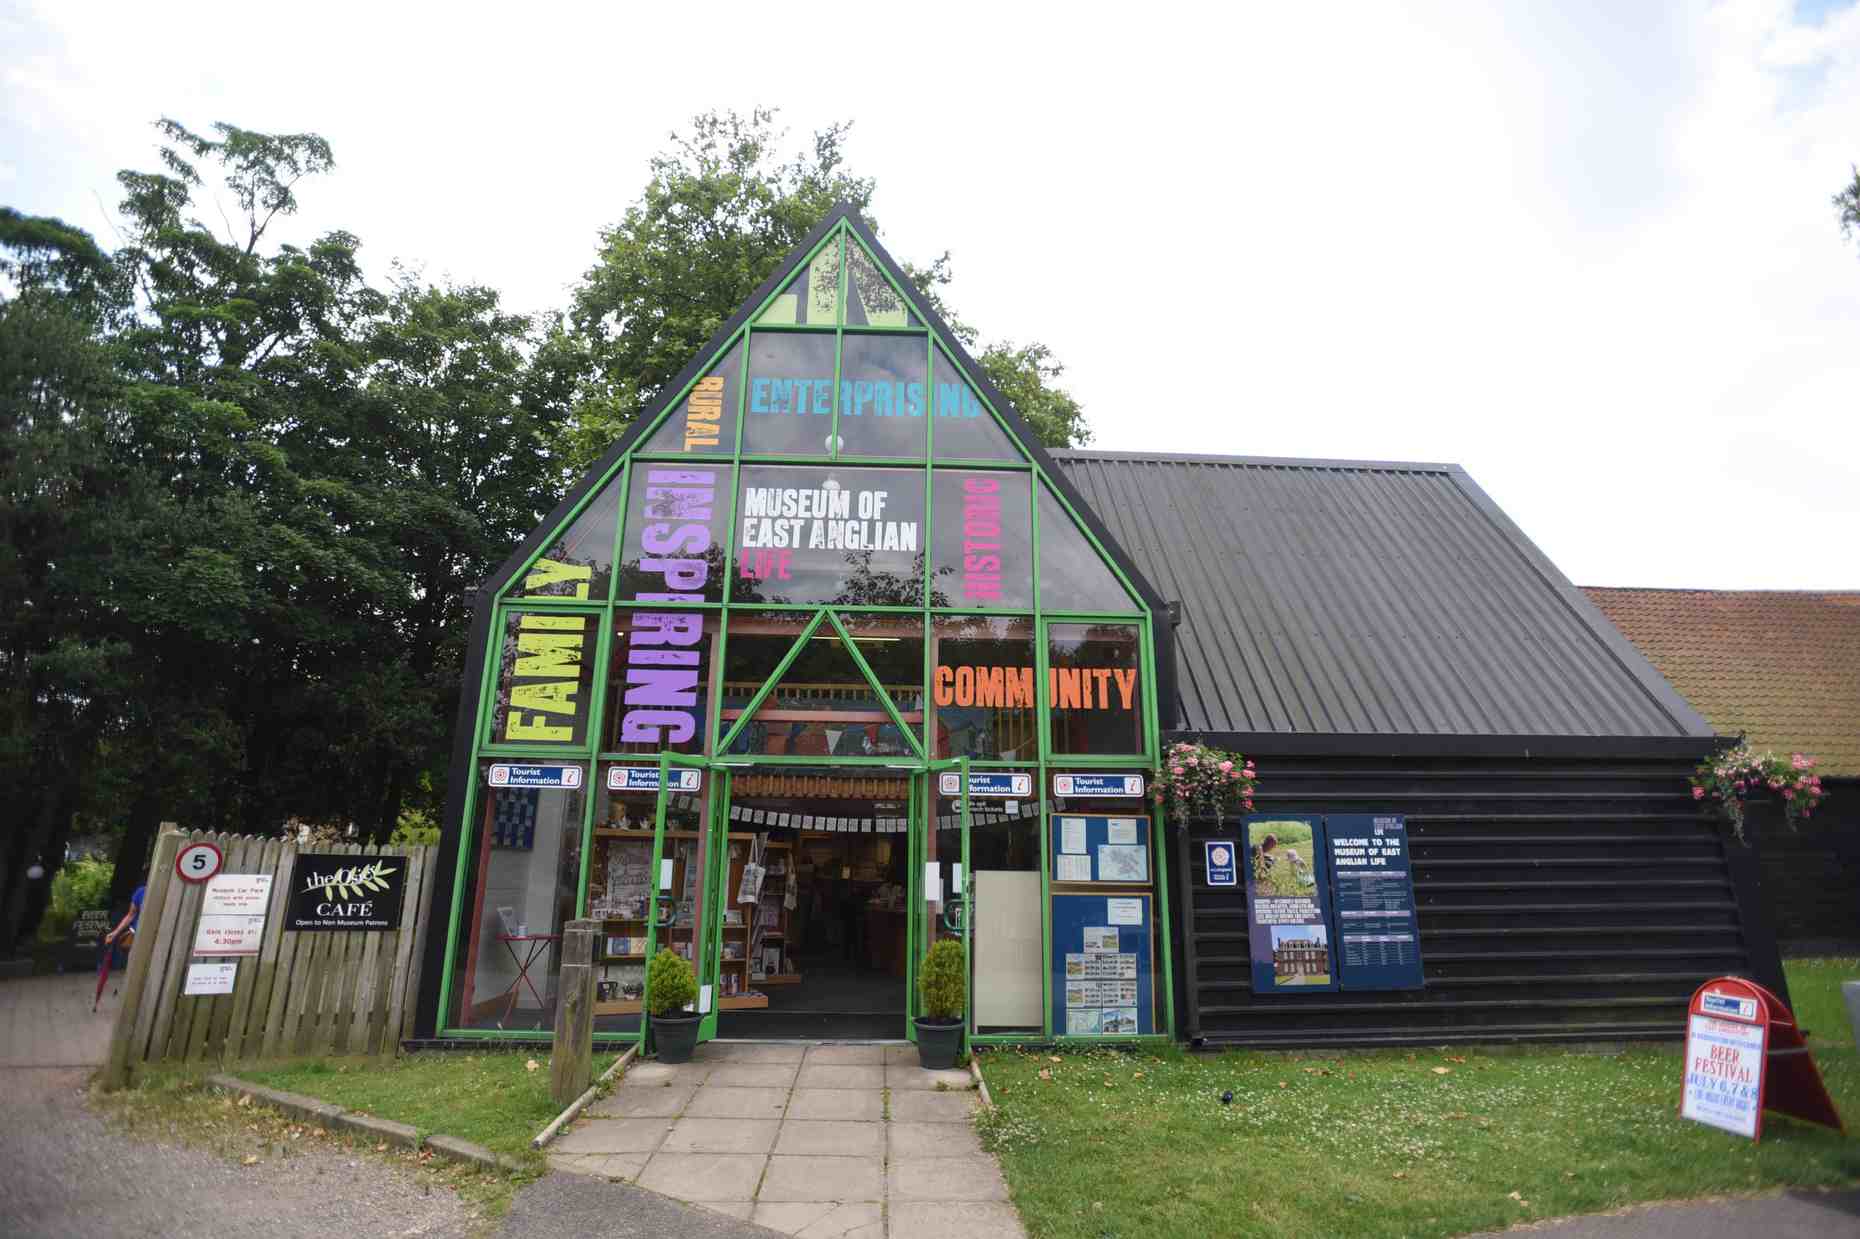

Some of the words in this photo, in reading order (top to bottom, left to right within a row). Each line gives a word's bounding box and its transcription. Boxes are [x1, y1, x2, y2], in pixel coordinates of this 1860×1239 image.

[684, 376, 725, 451] RURAL
[745, 487, 850, 520] MUSEUM
[858, 490, 889, 520] OF
[742, 517, 805, 549] EAST
[808, 518, 918, 552] ANGLIAN
[963, 478, 1002, 600] HISTORIC
[740, 549, 793, 580] LIFE
[620, 470, 717, 744] INSPIRING
[505, 557, 593, 742] FAMILY
[511, 767, 541, 777] Tourist
[630, 770, 660, 780] Tourist
[510, 776, 560, 786] Information
[1074, 777, 1104, 787] Tourist
[1074, 786, 1125, 795] Information
[1333, 838, 1369, 847] WELCOME
[1371, 839, 1383, 847] TO
[1385, 838, 1400, 847] THE
[1334, 847, 1366, 857] MUSEUM
[1368, 847, 1379, 857] OF
[1381, 847, 1401, 857] EAST
[192, 854, 207, 871] 5
[1370, 857, 1387, 866] LIFE
[306, 871, 333, 890] the
[316, 900, 374, 917] CAFÉ
[295, 919, 314, 927] Open
[1711, 1044, 1740, 1064] BEER
[1695, 1056, 1753, 1084] FESTIVAL
